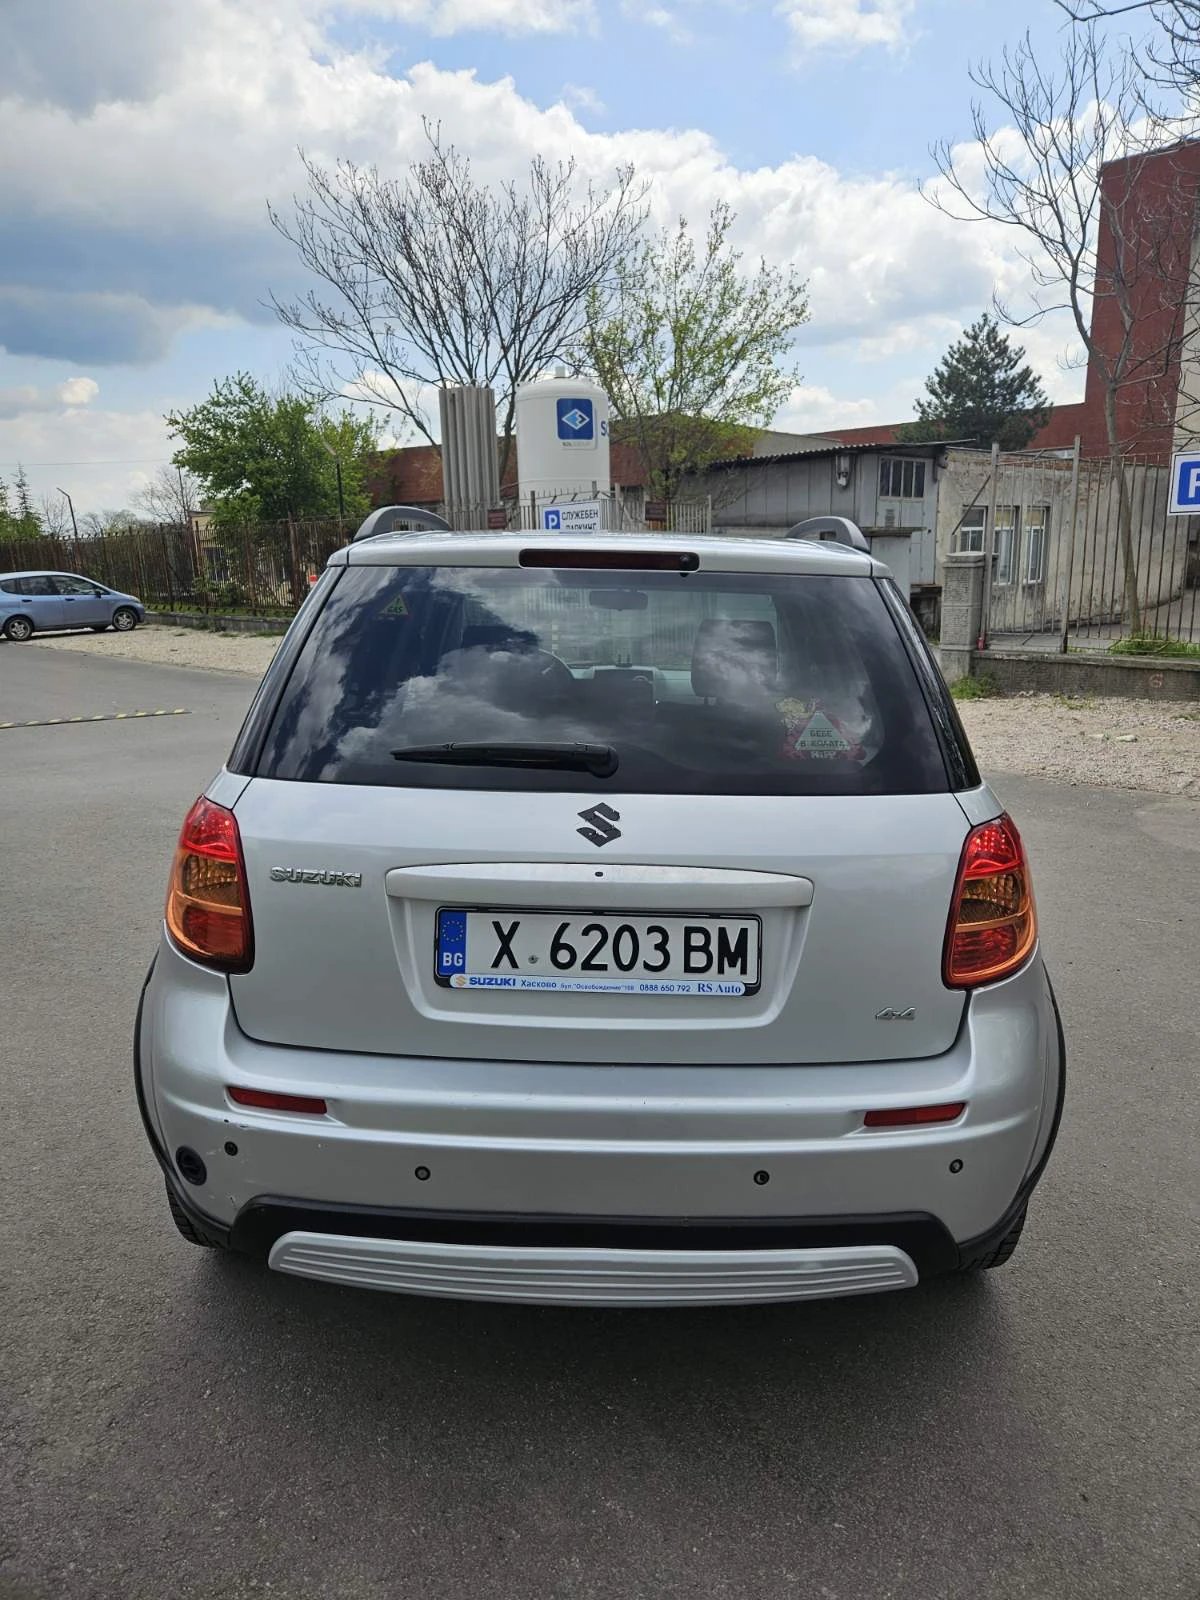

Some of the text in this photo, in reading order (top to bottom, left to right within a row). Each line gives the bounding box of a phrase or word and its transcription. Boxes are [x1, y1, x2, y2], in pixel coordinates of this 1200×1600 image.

[561, 509, 599, 521] СЛУЖЕБЕН
[270, 866, 362, 888] SUZUKI
[490, 920, 749, 976] X 6203 BM
[442, 952, 464, 968] BG
[469, 976, 517, 987] SUZUKI
[677, 984, 691, 993] 792
[697, 982, 713, 993] RS
[715, 983, 742, 994] Auto
